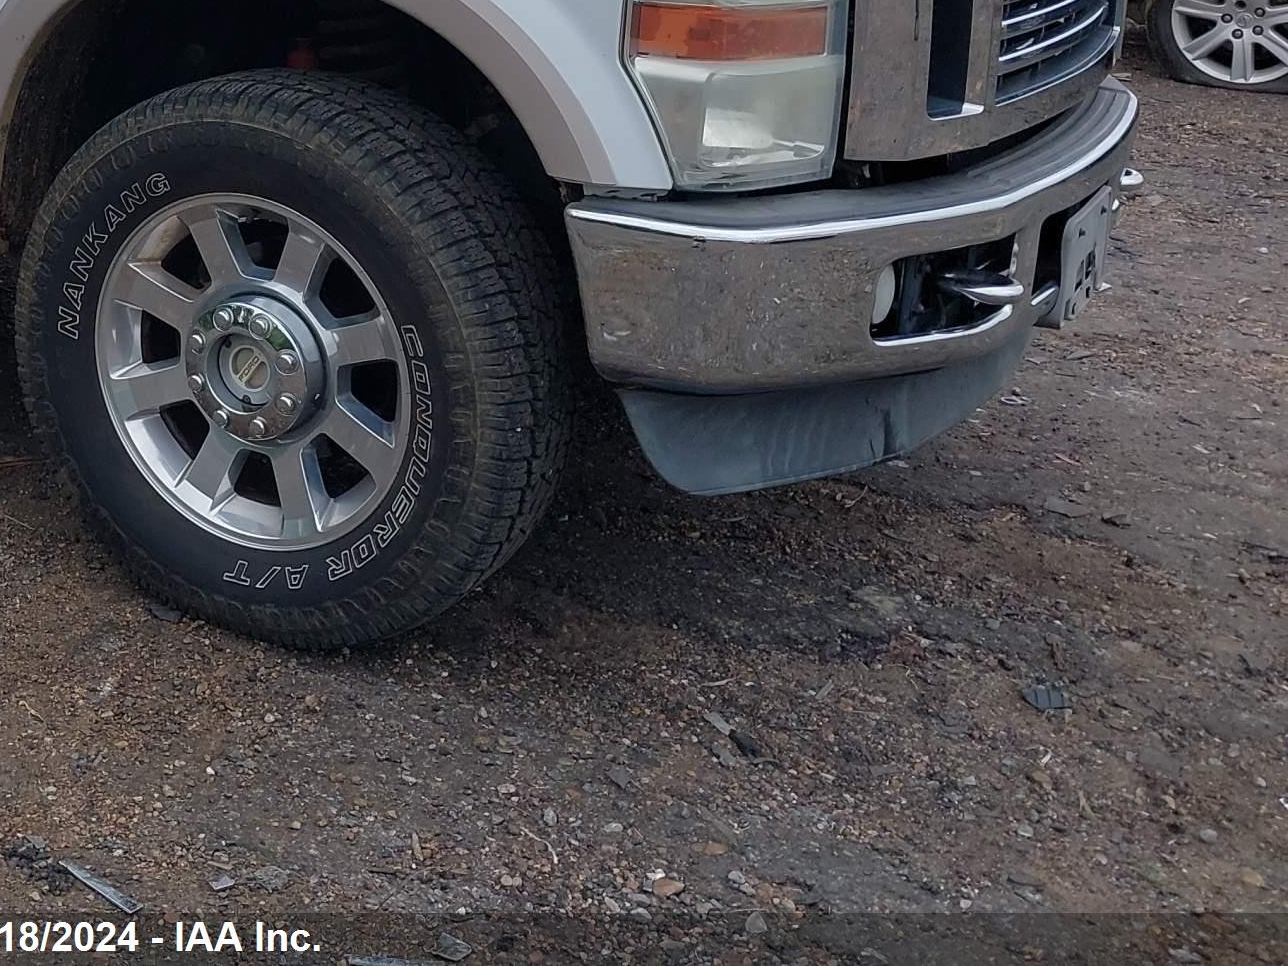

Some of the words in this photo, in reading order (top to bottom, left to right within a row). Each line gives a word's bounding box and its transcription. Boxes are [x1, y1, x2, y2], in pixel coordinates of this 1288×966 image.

[57, 172, 170, 340] NANKANG
[327, 322, 434, 581] CONQUEROR
[223, 559, 311, 590] A/T
